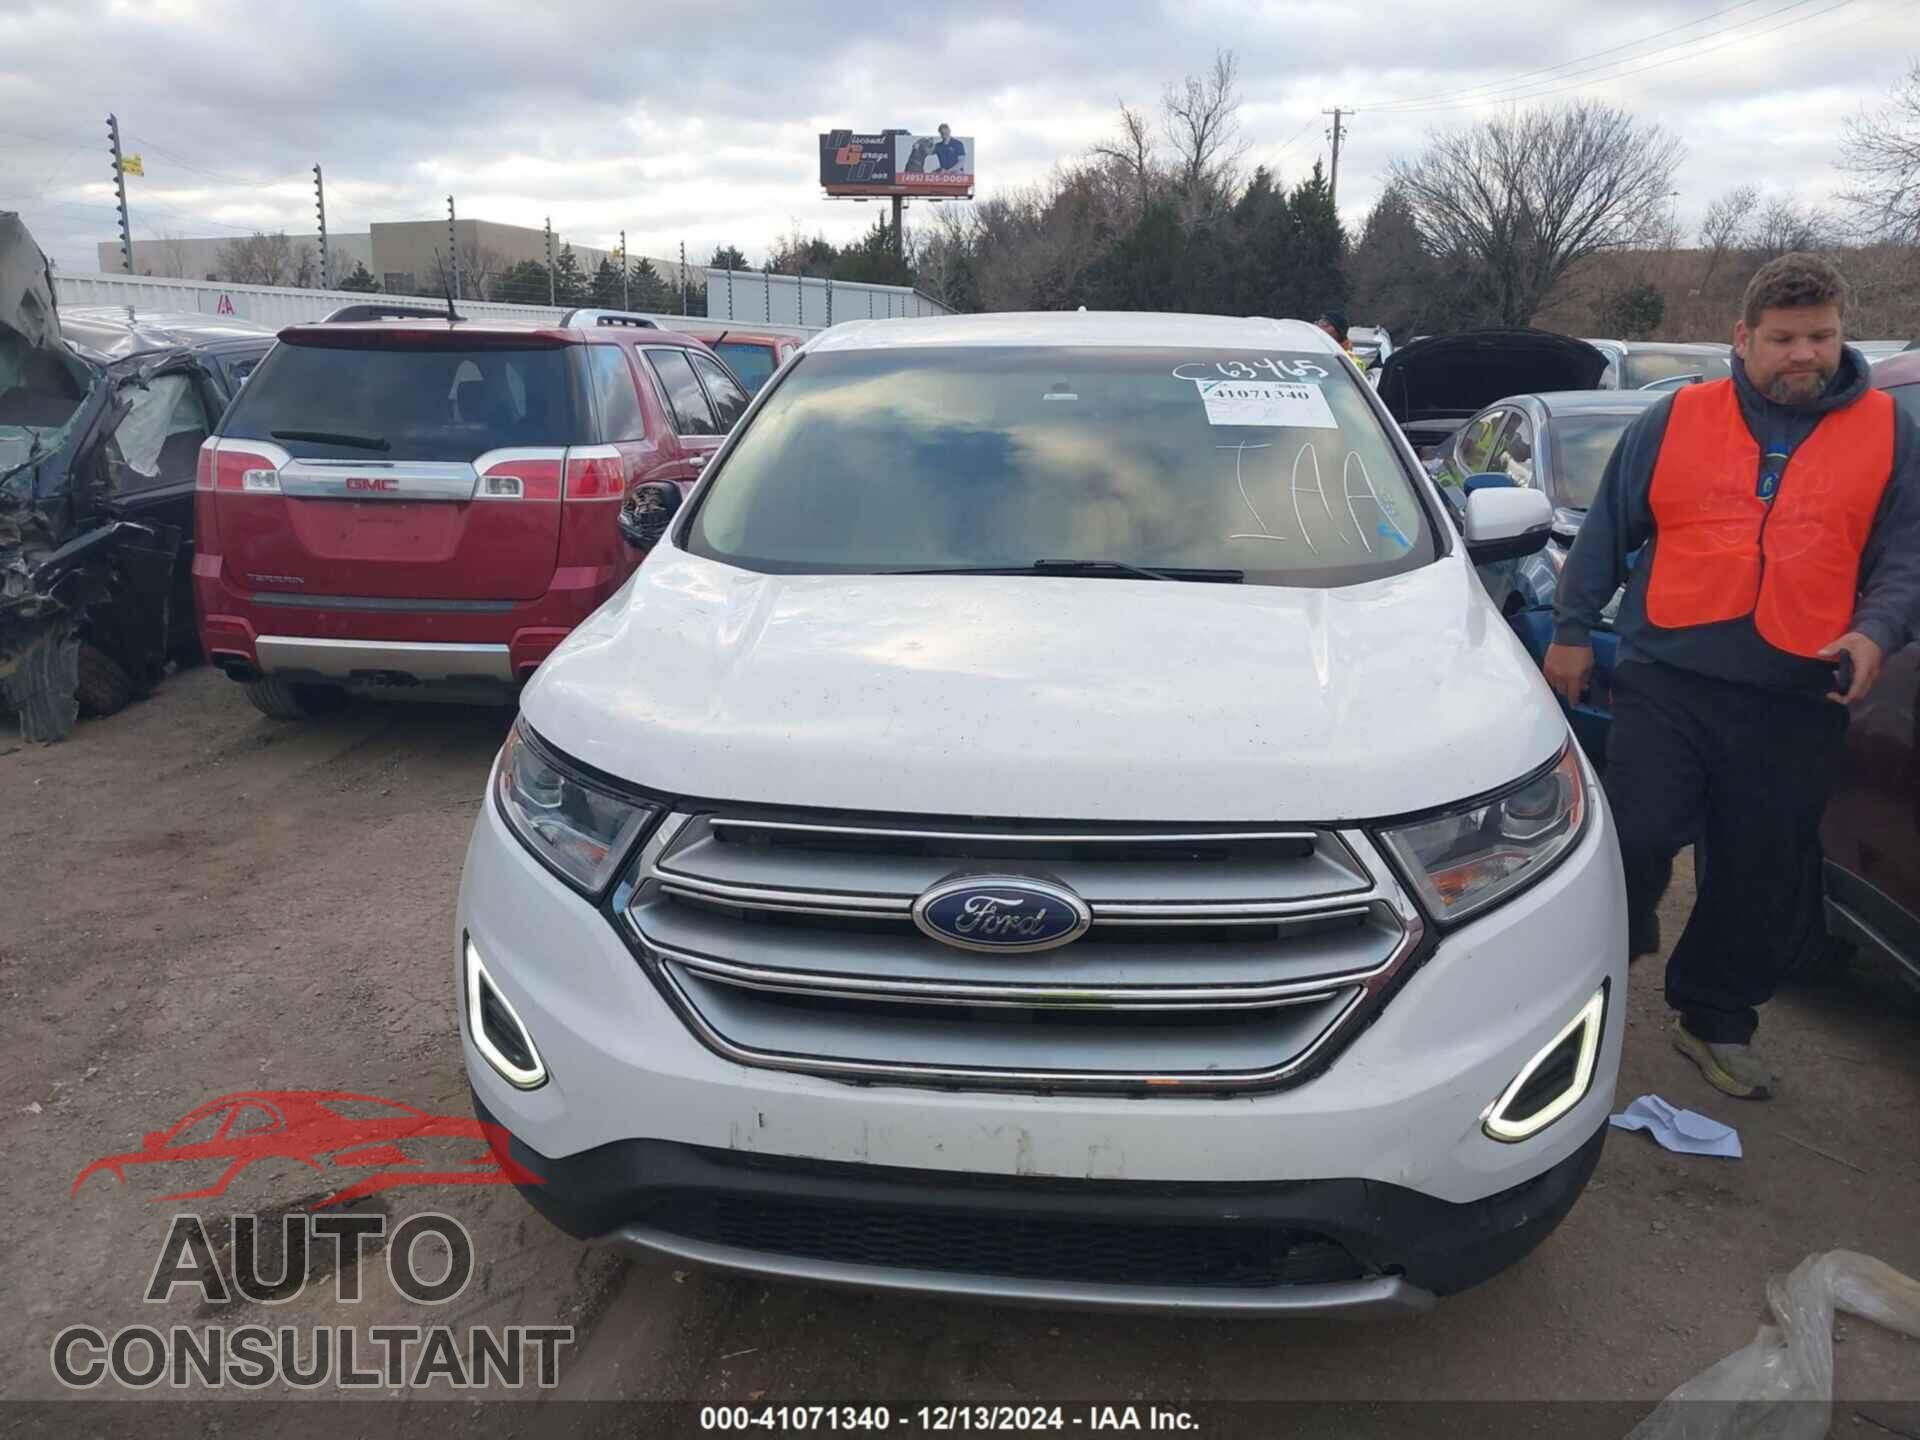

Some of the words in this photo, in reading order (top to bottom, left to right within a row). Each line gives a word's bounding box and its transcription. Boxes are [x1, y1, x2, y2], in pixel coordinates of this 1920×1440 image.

[824, 130, 886, 149] Discount
[835, 144, 889, 165] Garage
[847, 160, 888, 181] Door
[1213, 388, 1310, 401] 41071340
[346, 478, 399, 491] GMC
[954, 895, 1047, 935] Ford
